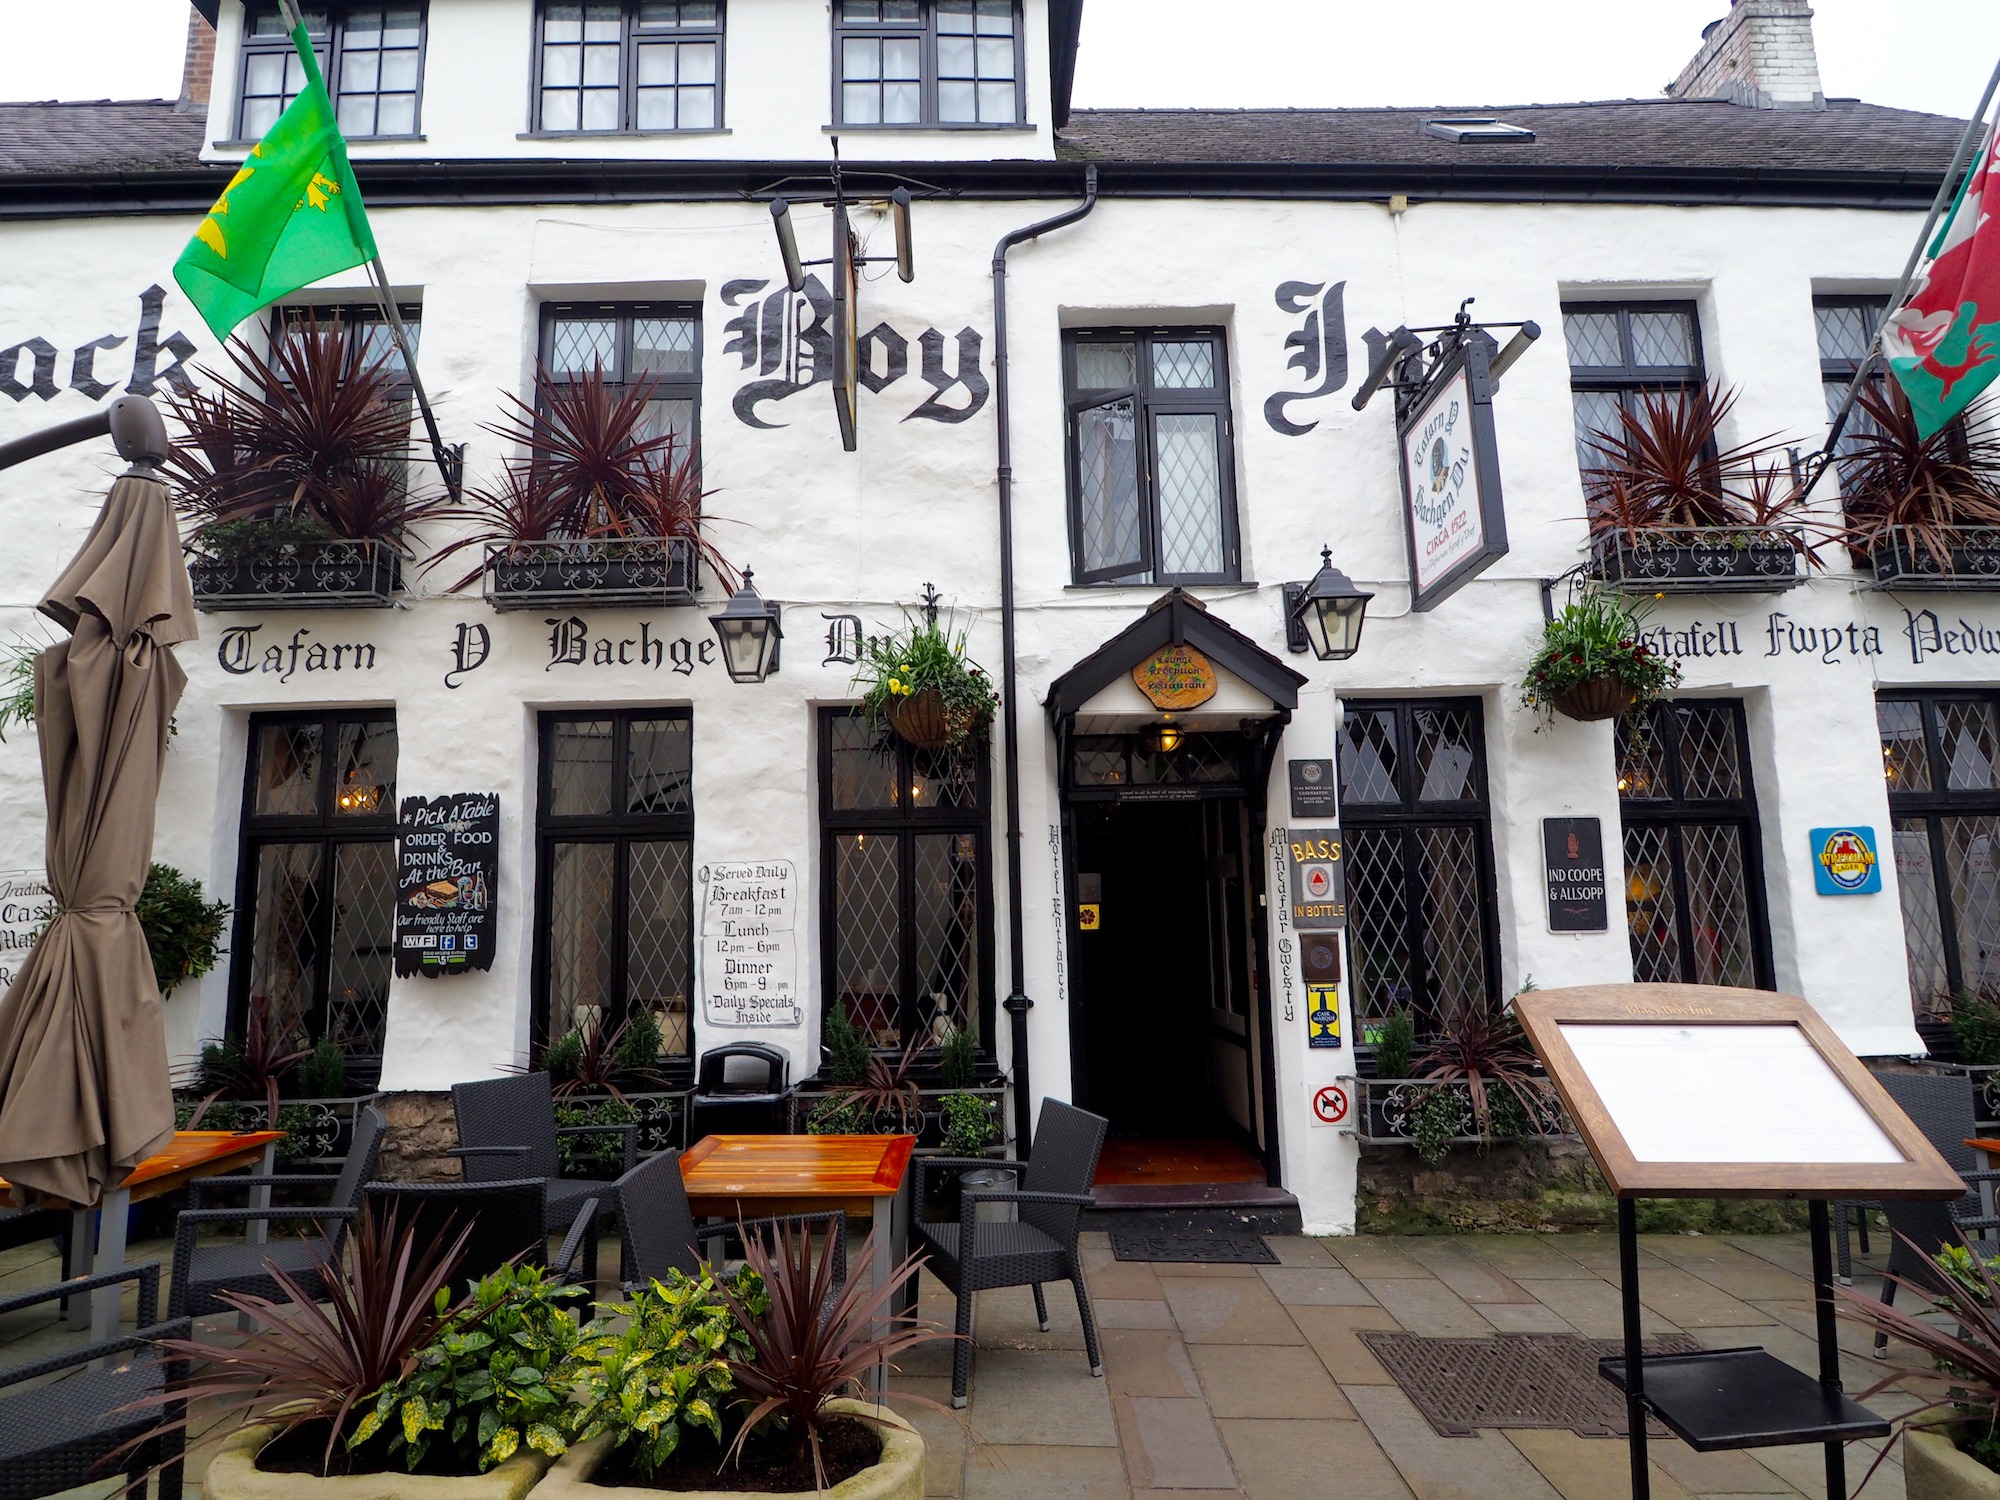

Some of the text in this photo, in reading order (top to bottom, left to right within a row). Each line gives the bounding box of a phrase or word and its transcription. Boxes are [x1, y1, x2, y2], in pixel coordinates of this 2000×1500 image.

[720, 272, 990, 429] Boy
[1425, 510, 1468, 557] CIRCA 1522
[1764, 612, 1884, 665] Fwyta
[218, 623, 376, 684] Tafarn
[545, 614, 716, 676] Bachge
[413, 799, 494, 827] Pick A Table
[405, 832, 492, 846] ORDER FOOD
[437, 845, 447, 853] &
[1290, 839, 1342, 862] BASS
[403, 852, 453, 866] DRINKS
[1818, 851, 1875, 866] WREXHAM
[399, 858, 481, 888] At the Bar
[713, 865, 787, 881] Served Daily
[1548, 868, 1603, 882] IND COOPE
[1836, 864, 1859, 872] LAGER
[0, 881, 49, 900] Traditi
[709, 885, 787, 905] Breakfast
[1550, 887, 1604, 901] & ALLSOPP
[1048, 825, 1064, 1000] Hotel Entrance
[1294, 904, 1345, 917] IN BOTTLE
[397, 911, 485, 927] Our friendly Staff are
[426, 922, 473, 935] here to help
[720, 920, 769, 937] Lunch
[757, 940, 780, 954] 6pm
[724, 958, 773, 974] Dinner
[724, 976, 748, 991] 6pm
[1278, 938, 1294, 1022] Gwesty
[713, 993, 794, 1011] Daily Specials
[735, 1009, 771, 1023] Inside
